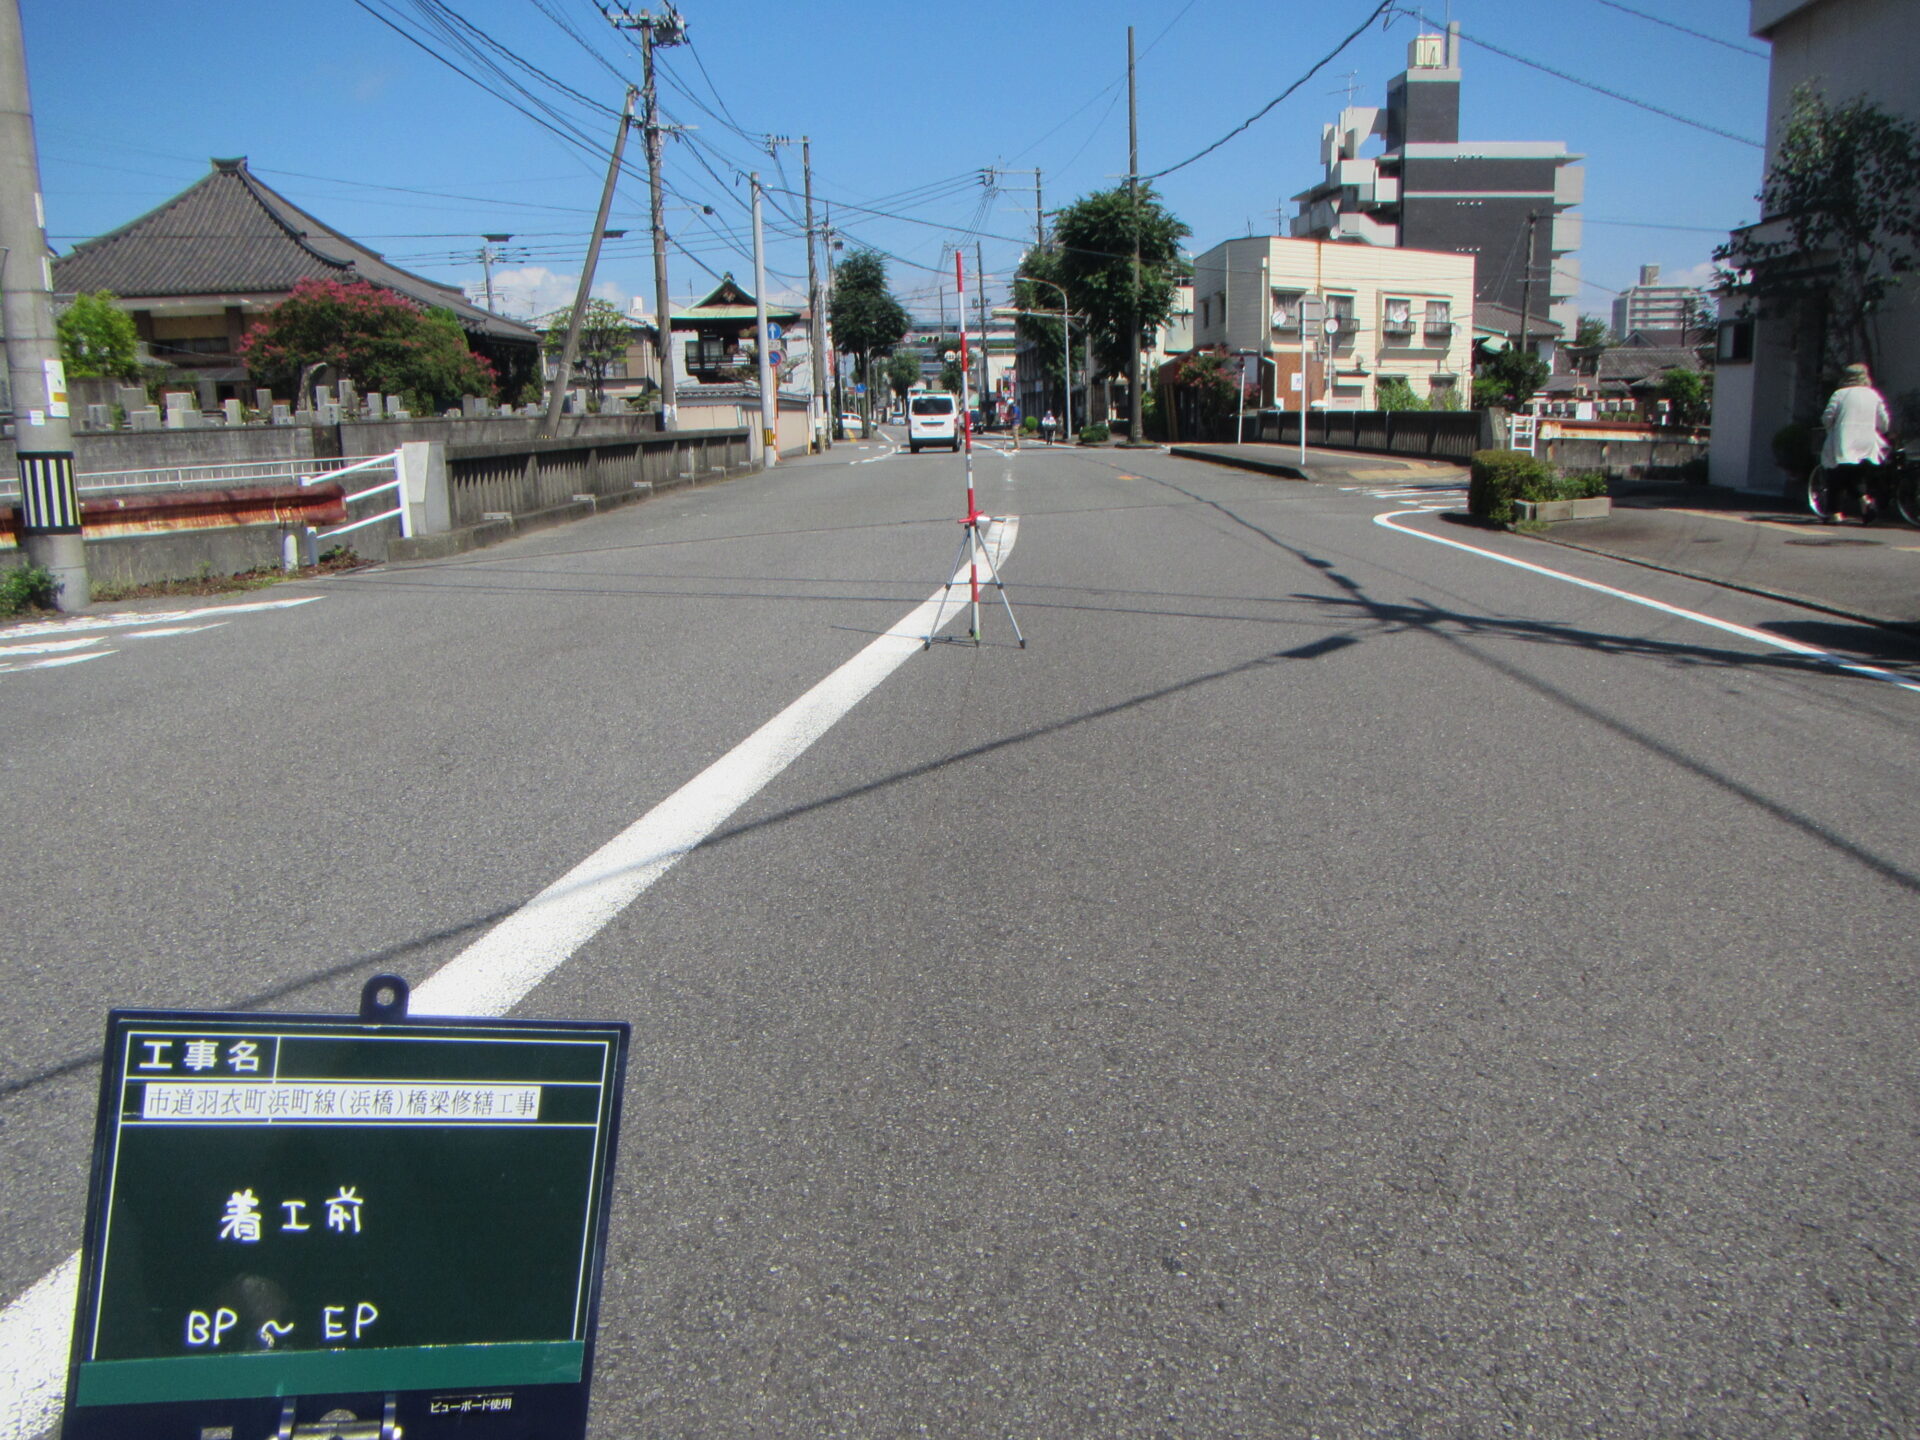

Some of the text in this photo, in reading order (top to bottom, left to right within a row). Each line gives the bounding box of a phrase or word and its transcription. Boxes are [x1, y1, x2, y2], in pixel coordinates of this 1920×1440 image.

[139, 1040, 259, 1072] 工事名
[220, 1186, 364, 1241] 着工前
[187, 1308, 238, 1345] BP
[323, 1302, 379, 1339] EP
